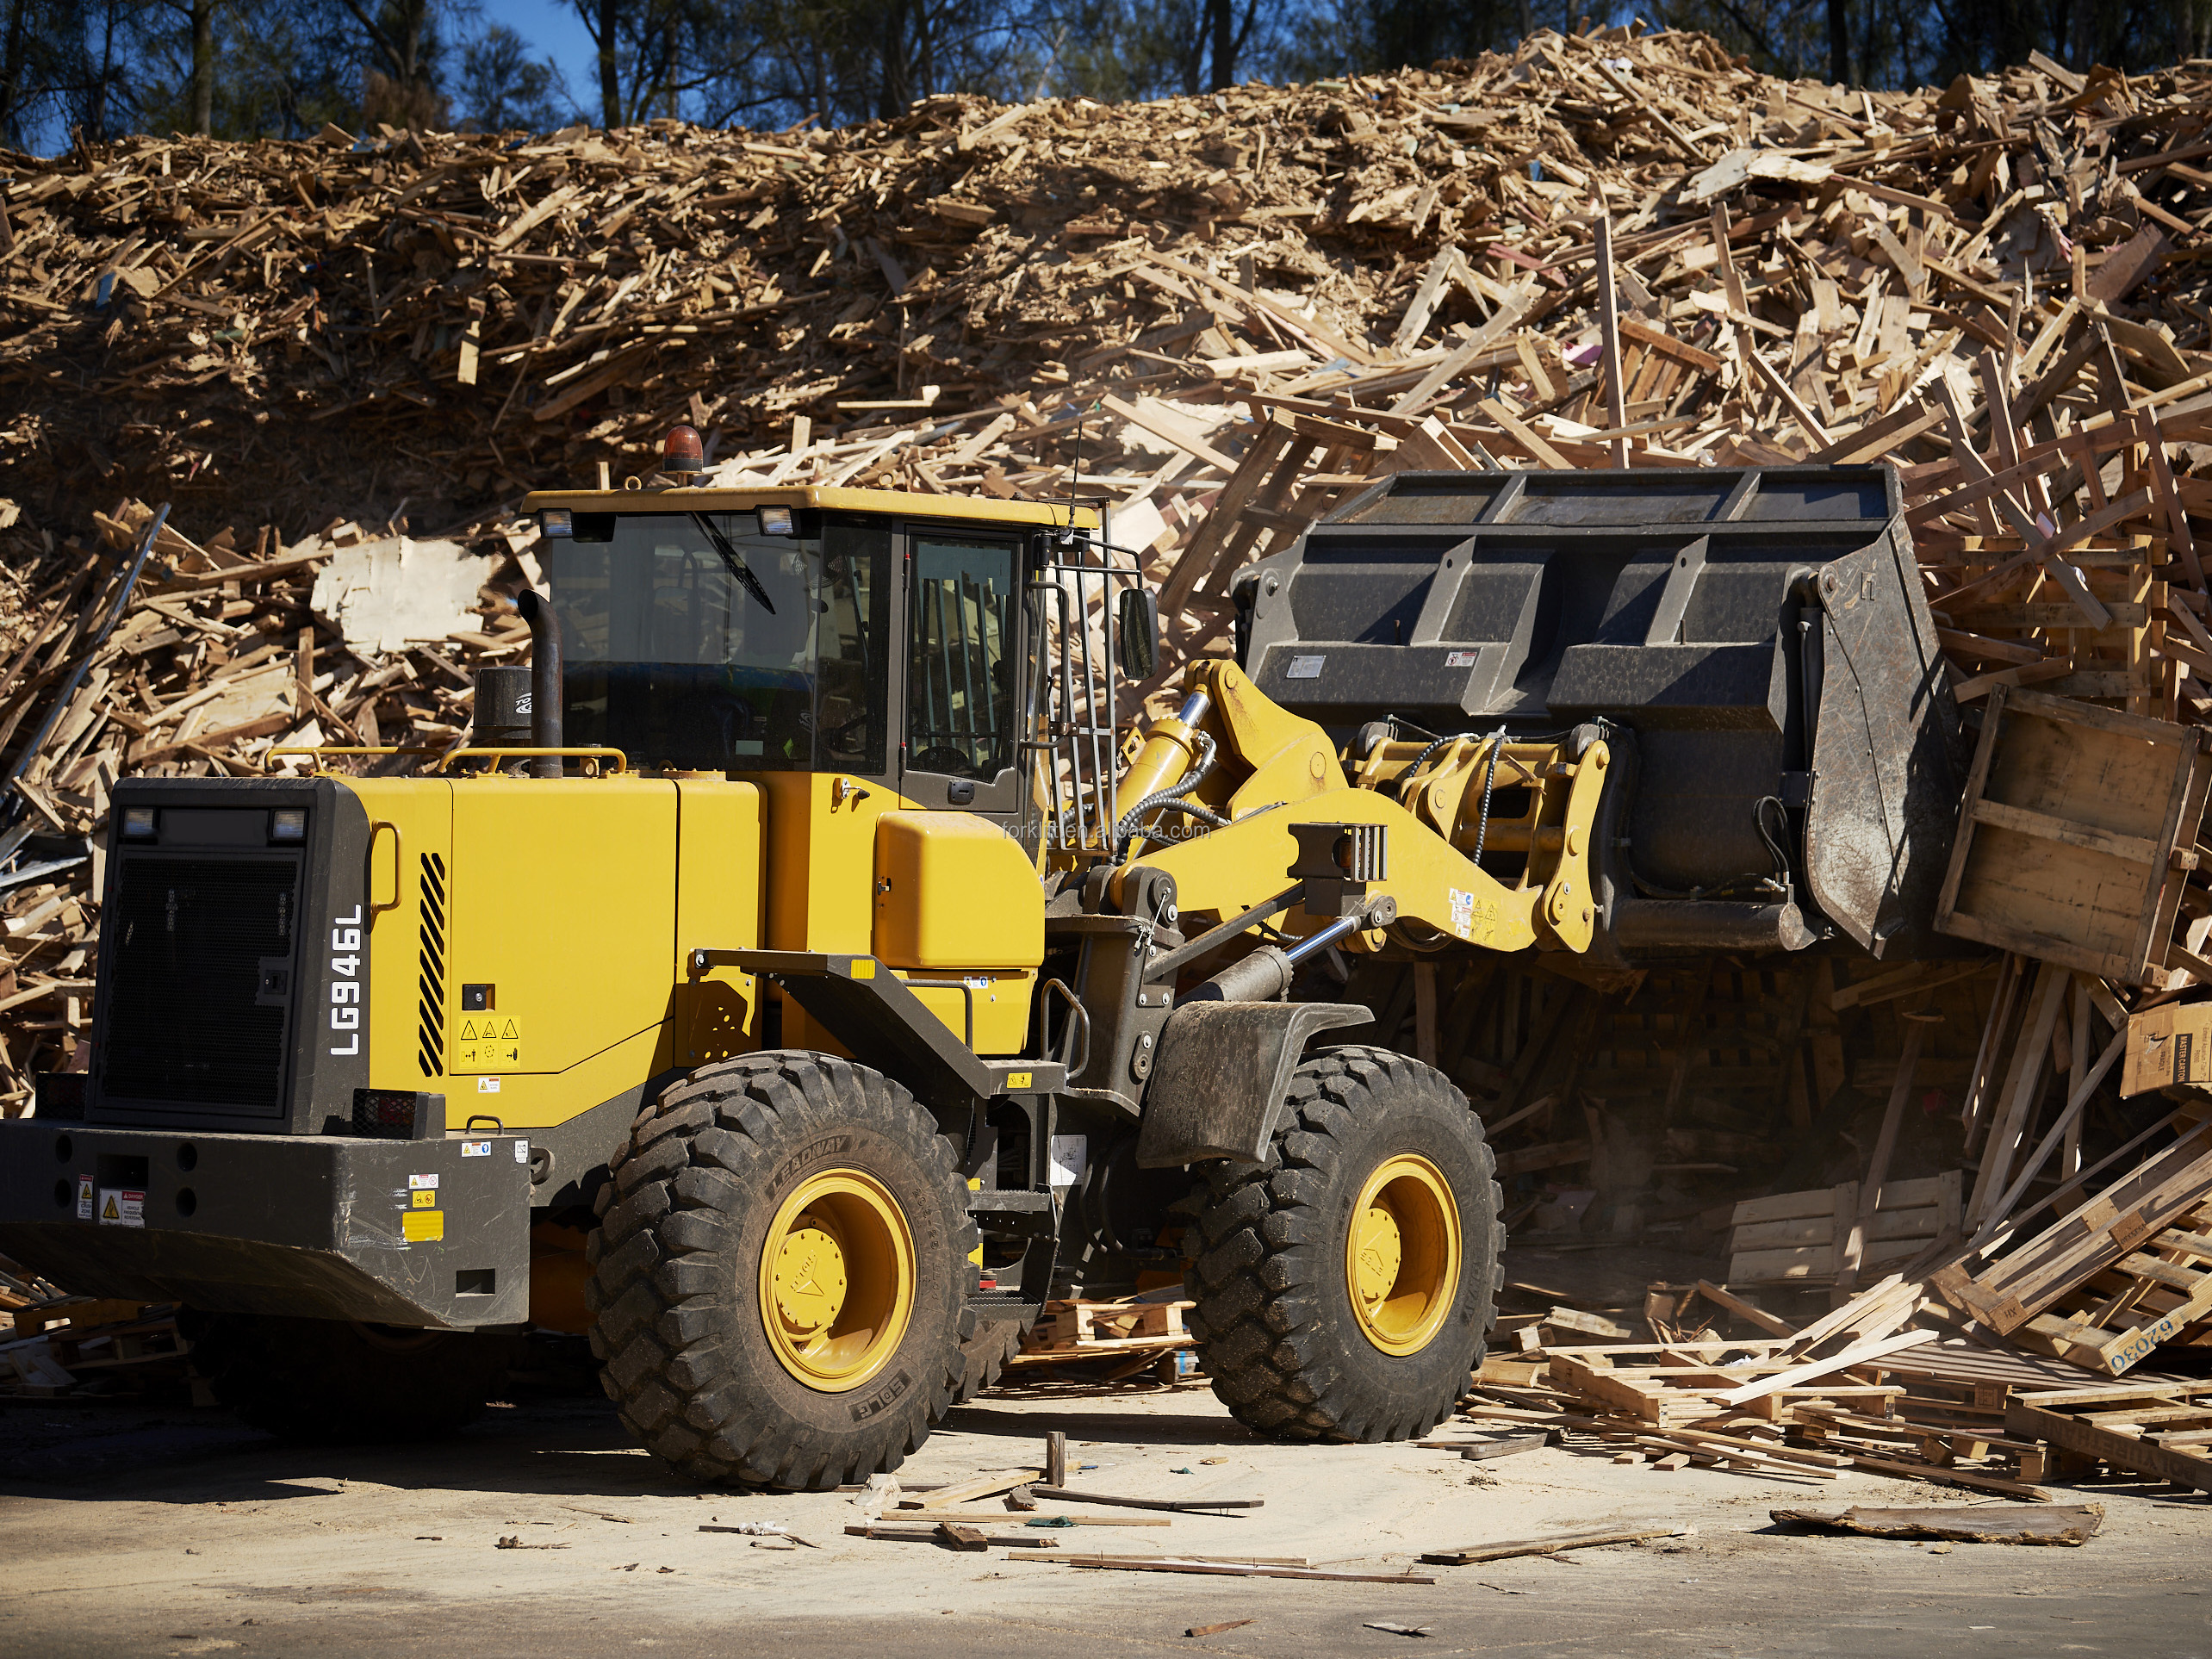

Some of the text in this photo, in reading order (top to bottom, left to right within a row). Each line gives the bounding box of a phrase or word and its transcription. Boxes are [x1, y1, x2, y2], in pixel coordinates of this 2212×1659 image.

[330, 904, 362, 1055] LG946L
[2177, 1035, 2188, 1083] MASTER CARTON
[772, 1137, 847, 1195] LEADWAY
[2111, 1320, 2174, 1370] 62030
[857, 1376, 906, 1419] SDLG
